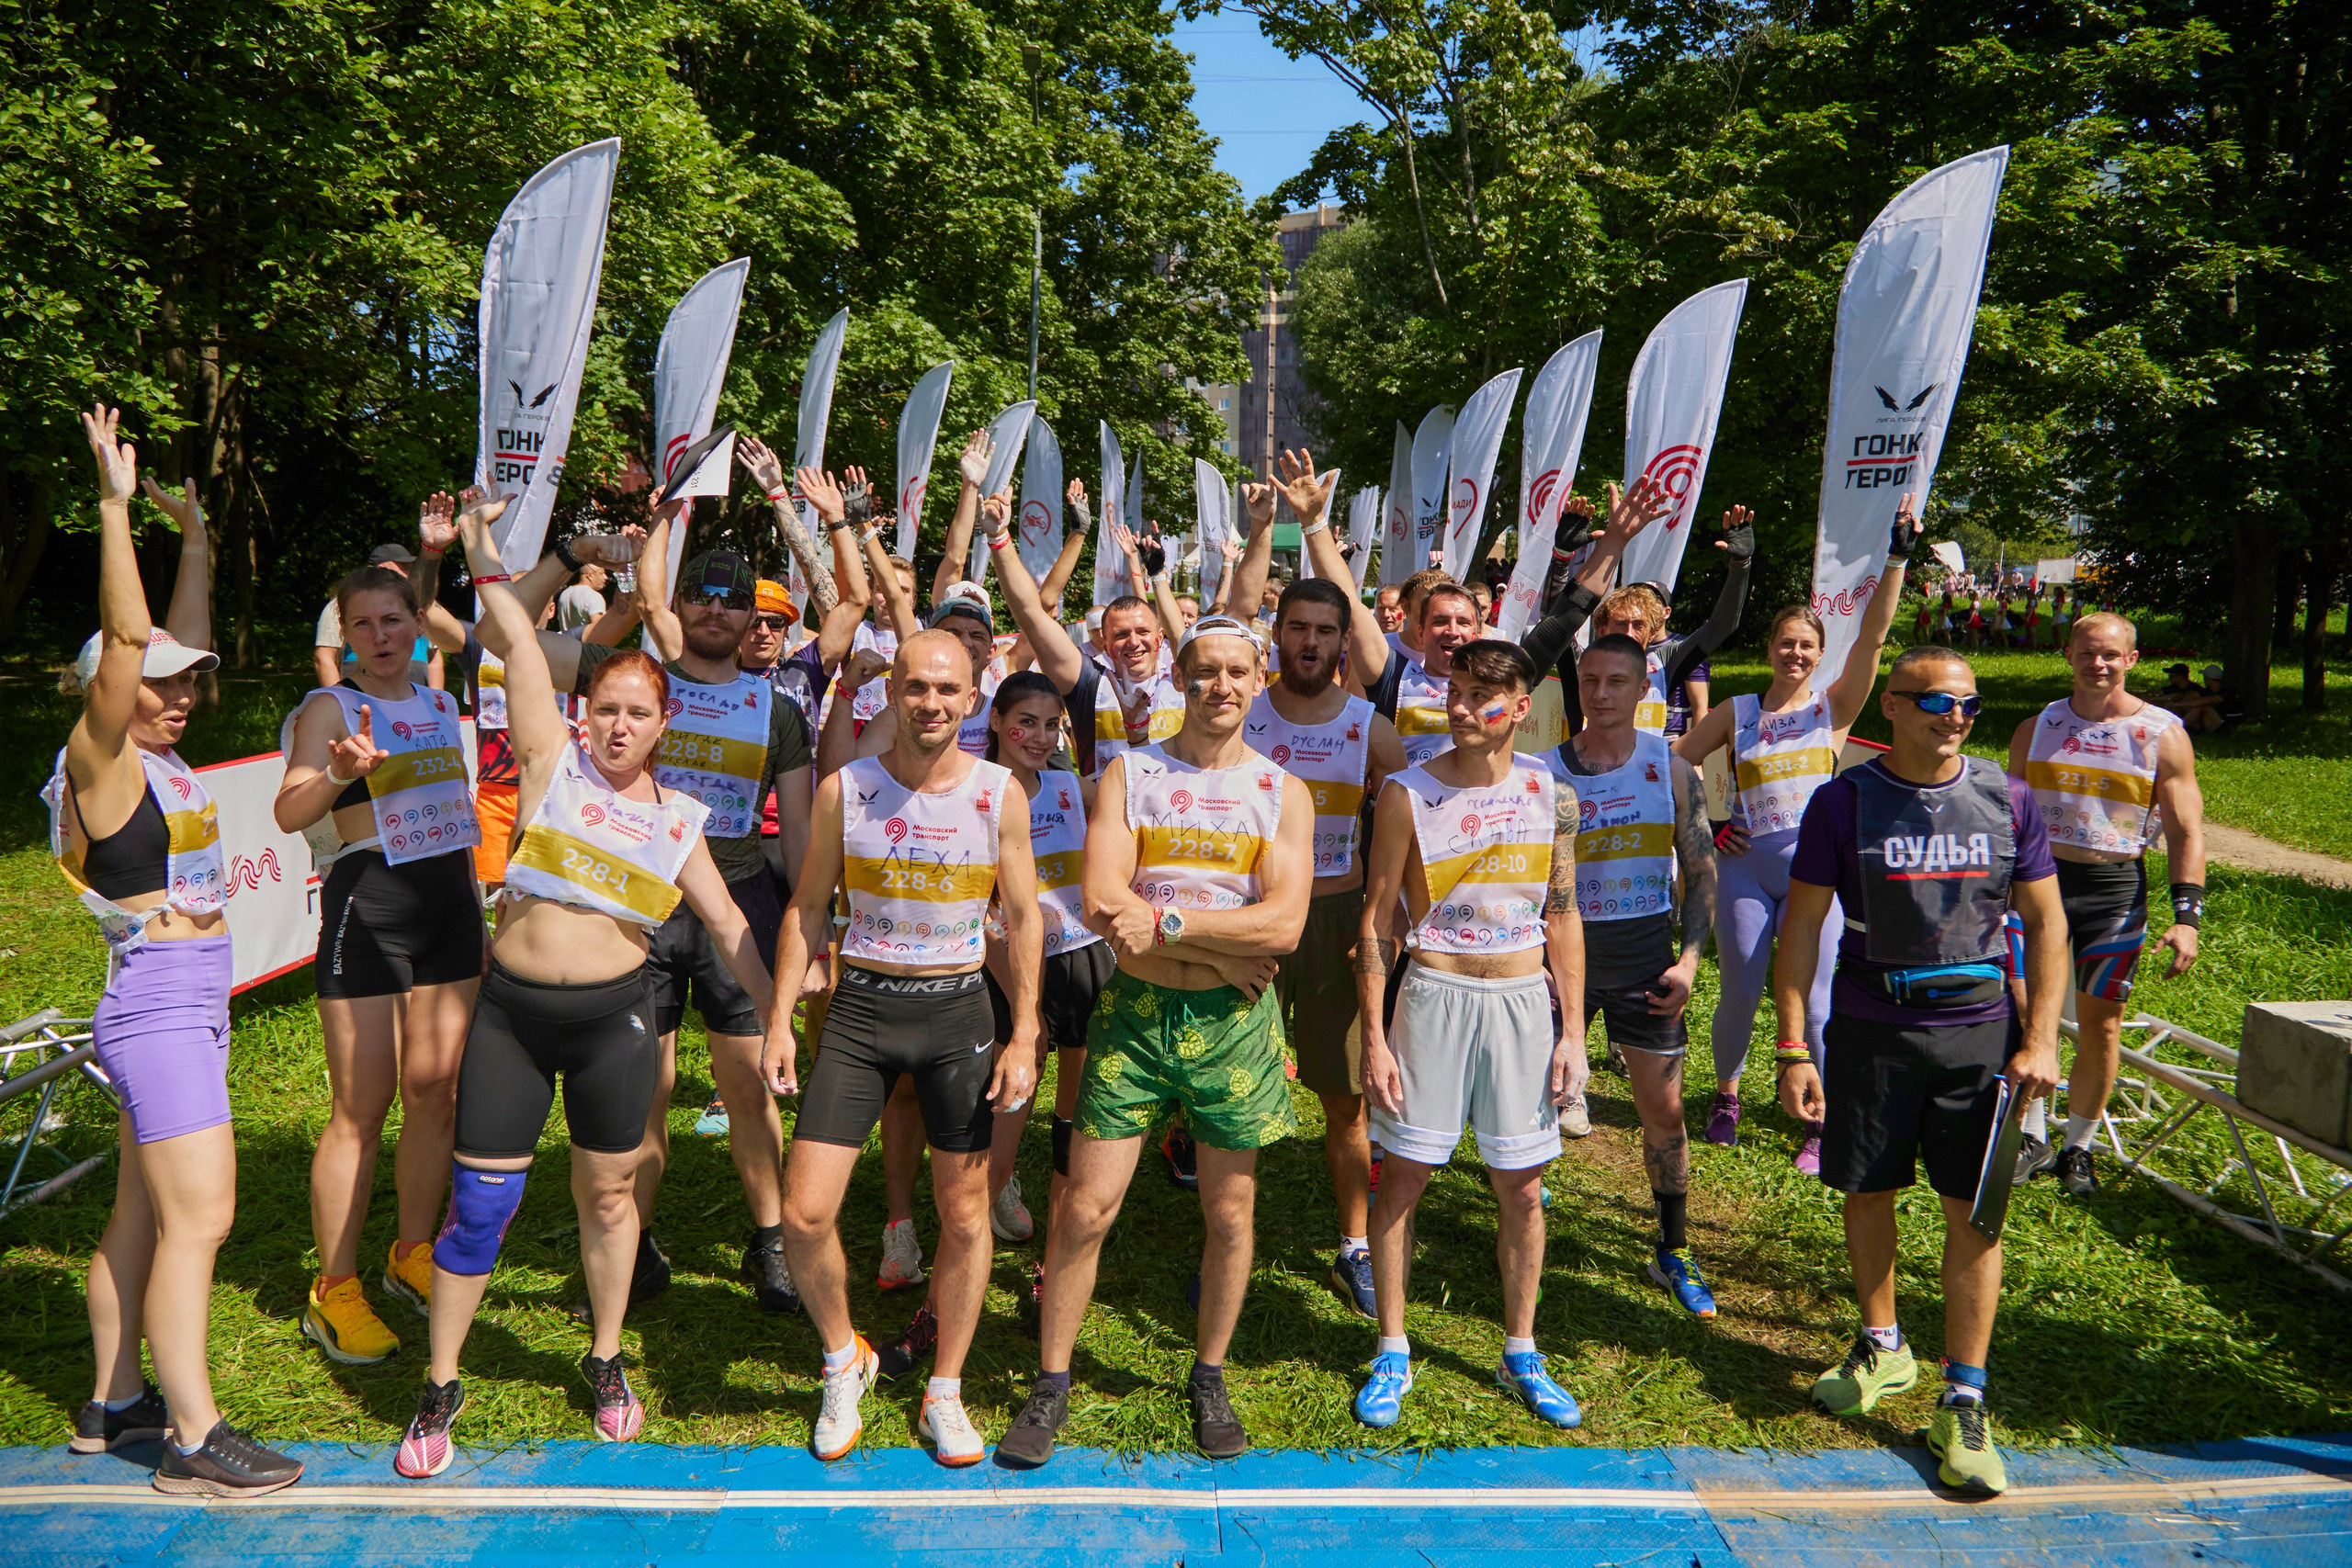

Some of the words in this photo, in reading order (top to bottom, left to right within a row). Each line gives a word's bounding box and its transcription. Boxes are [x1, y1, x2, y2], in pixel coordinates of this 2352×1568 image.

[687, 710, 721, 720] транспорт
[688, 704, 728, 716] Московский
[1762, 716, 1796, 731] ЛИЗА
[413, 735, 448, 755] КАТЯ
[659, 738, 724, 763] 228-8
[1295, 749, 1332, 757] Московский
[2084, 742, 2119, 750] Московский
[412, 756, 461, 776] 232-4
[1763, 756, 1810, 776] 231-2
[2058, 771, 2111, 791] 231-5
[1198, 796, 1241, 806] Московский
[1198, 804, 1233, 812] транспорт
[1600, 795, 1636, 807] Московский
[1601, 802, 1631, 812] транспорт
[1484, 809, 1517, 820] Московский
[607, 823, 643, 843] транспорт
[609, 818, 652, 841] Московский
[912, 824, 958, 834] Московский
[912, 832, 950, 841] транспорт
[1151, 812, 1254, 845] МИХА
[1168, 838, 1238, 862] 228-7
[1587, 832, 1642, 853] 228-2
[879, 845, 972, 879] ЛЕХА
[1884, 833, 1991, 873] СУДЬЯ
[560, 848, 629, 894] 228-1
[881, 869, 955, 893] 228-6
[334, 937, 343, 974] EAZYWAY
[876, 977, 959, 993] NIKE
